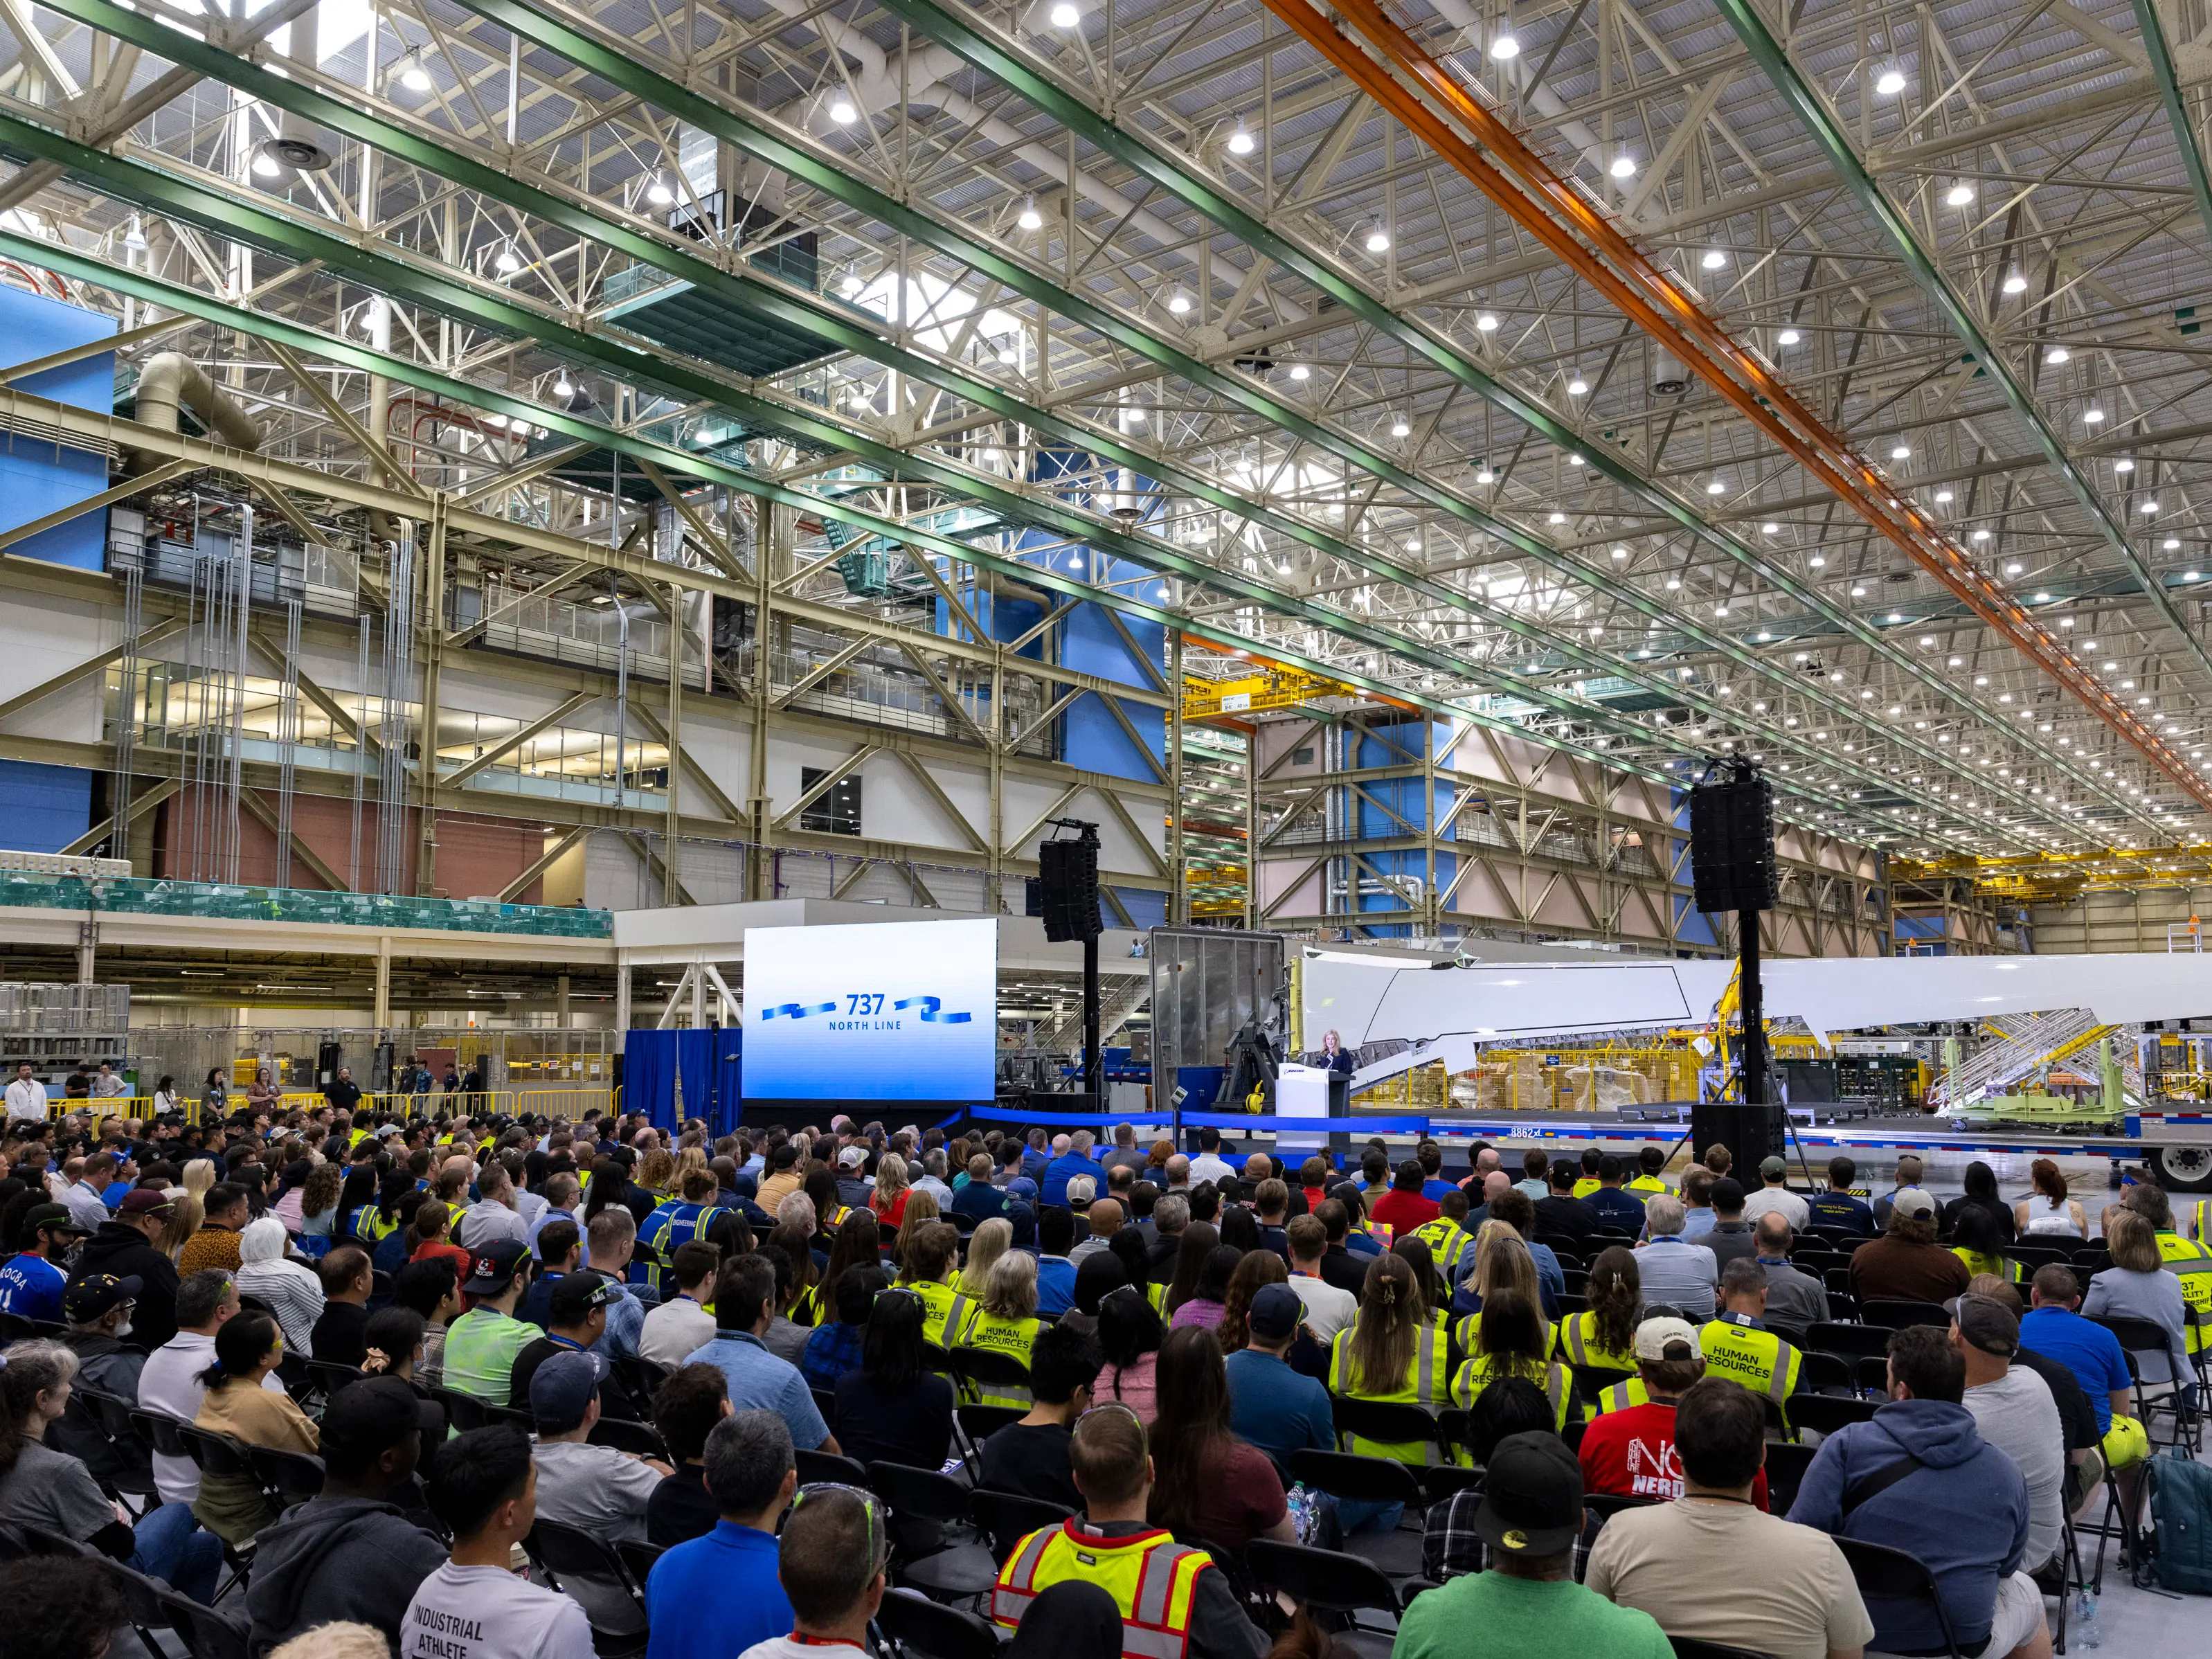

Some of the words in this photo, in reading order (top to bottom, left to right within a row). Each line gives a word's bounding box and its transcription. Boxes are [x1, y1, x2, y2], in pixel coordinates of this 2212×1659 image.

[846, 994, 885, 1015] 737
[829, 1021, 868, 1030] NORTH
[875, 1021, 901, 1030] LINE
[672, 1219, 696, 1228] ENGINEERING
[2182, 1282, 2195, 1291] 37
[2182, 1290, 2204, 1298] ALITY
[986, 1327, 1020, 1338] HUMAN
[976, 1335, 1029, 1349] RESOURCES
[1713, 1345, 1759, 1365] HUMAN
[413, 1604, 483, 1642] INDUSTRIAL
[419, 1633, 467, 1659] ATHLETE
